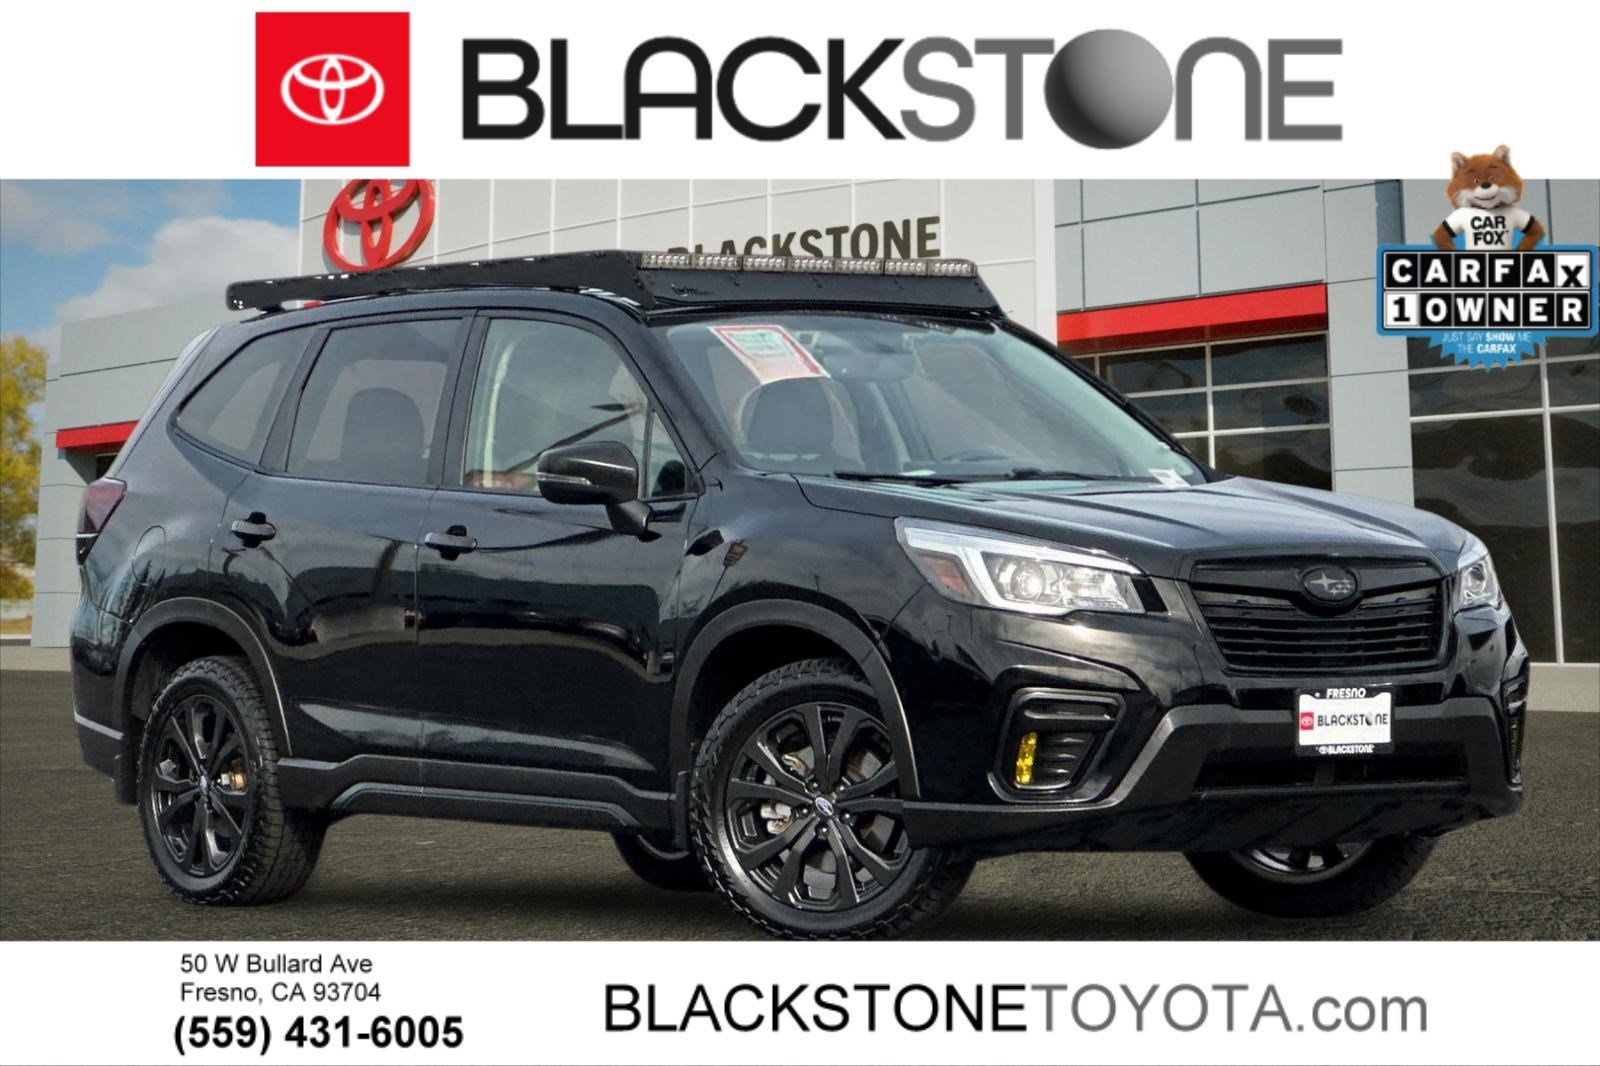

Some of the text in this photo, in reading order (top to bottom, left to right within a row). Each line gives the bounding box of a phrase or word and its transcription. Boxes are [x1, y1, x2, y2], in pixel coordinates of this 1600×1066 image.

[668, 216, 940, 259] KSTONE
[1326, 687, 1367, 699] FRESNO
[1317, 712, 1389, 727] BLACKSTONE
[1327, 744, 1374, 755] BLACKSTONE
